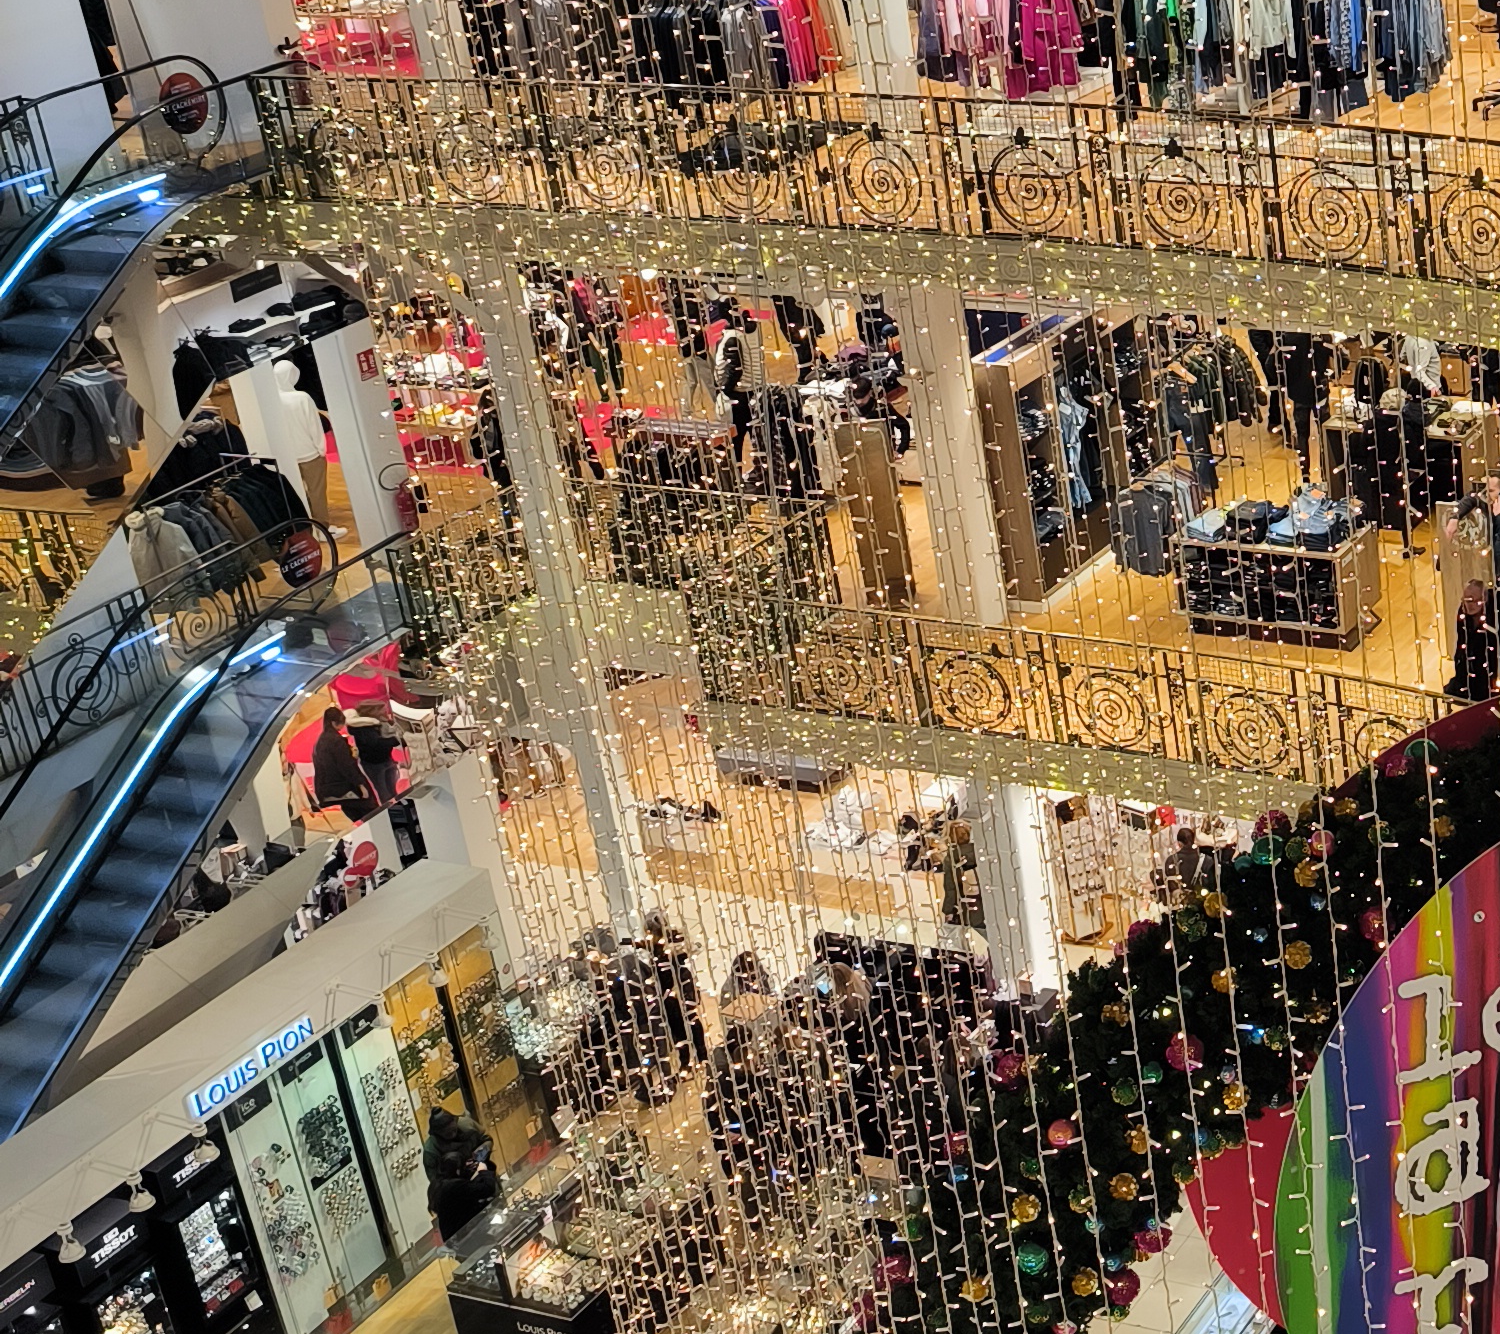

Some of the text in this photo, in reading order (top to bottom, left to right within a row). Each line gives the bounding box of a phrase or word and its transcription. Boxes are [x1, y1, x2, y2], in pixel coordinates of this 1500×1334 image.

[193, 1018, 315, 1117] LOUIS PION
[91, 1224, 136, 1263] TISSOT
